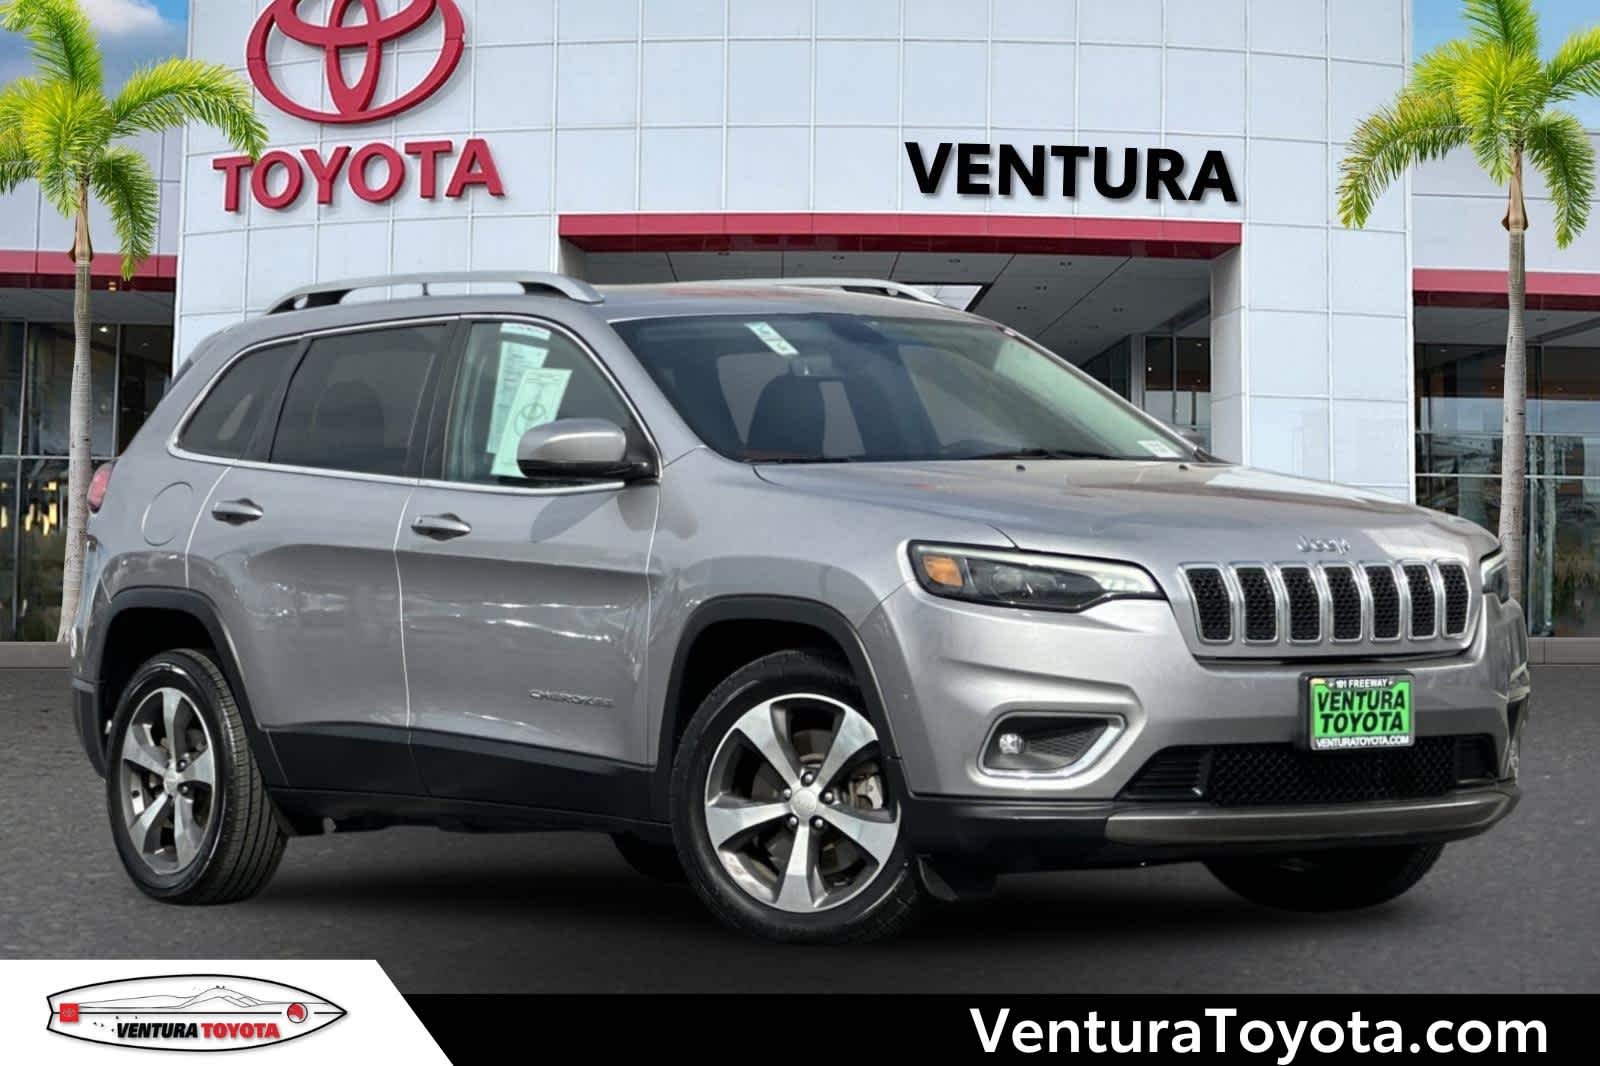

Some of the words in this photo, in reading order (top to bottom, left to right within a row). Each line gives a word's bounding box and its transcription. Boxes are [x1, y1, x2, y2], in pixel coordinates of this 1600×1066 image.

[212, 138, 505, 212] TOYOTA
[904, 141, 1239, 202] VENTURA
[1295, 535, 1351, 555] Jeep
[1348, 679, 1387, 688] FREEWAY
[1317, 690, 1405, 711] VENTURA
[1320, 712, 1403, 733] TOYOTA
[1316, 735, 1409, 748] VENTURATOYOTA.COM
